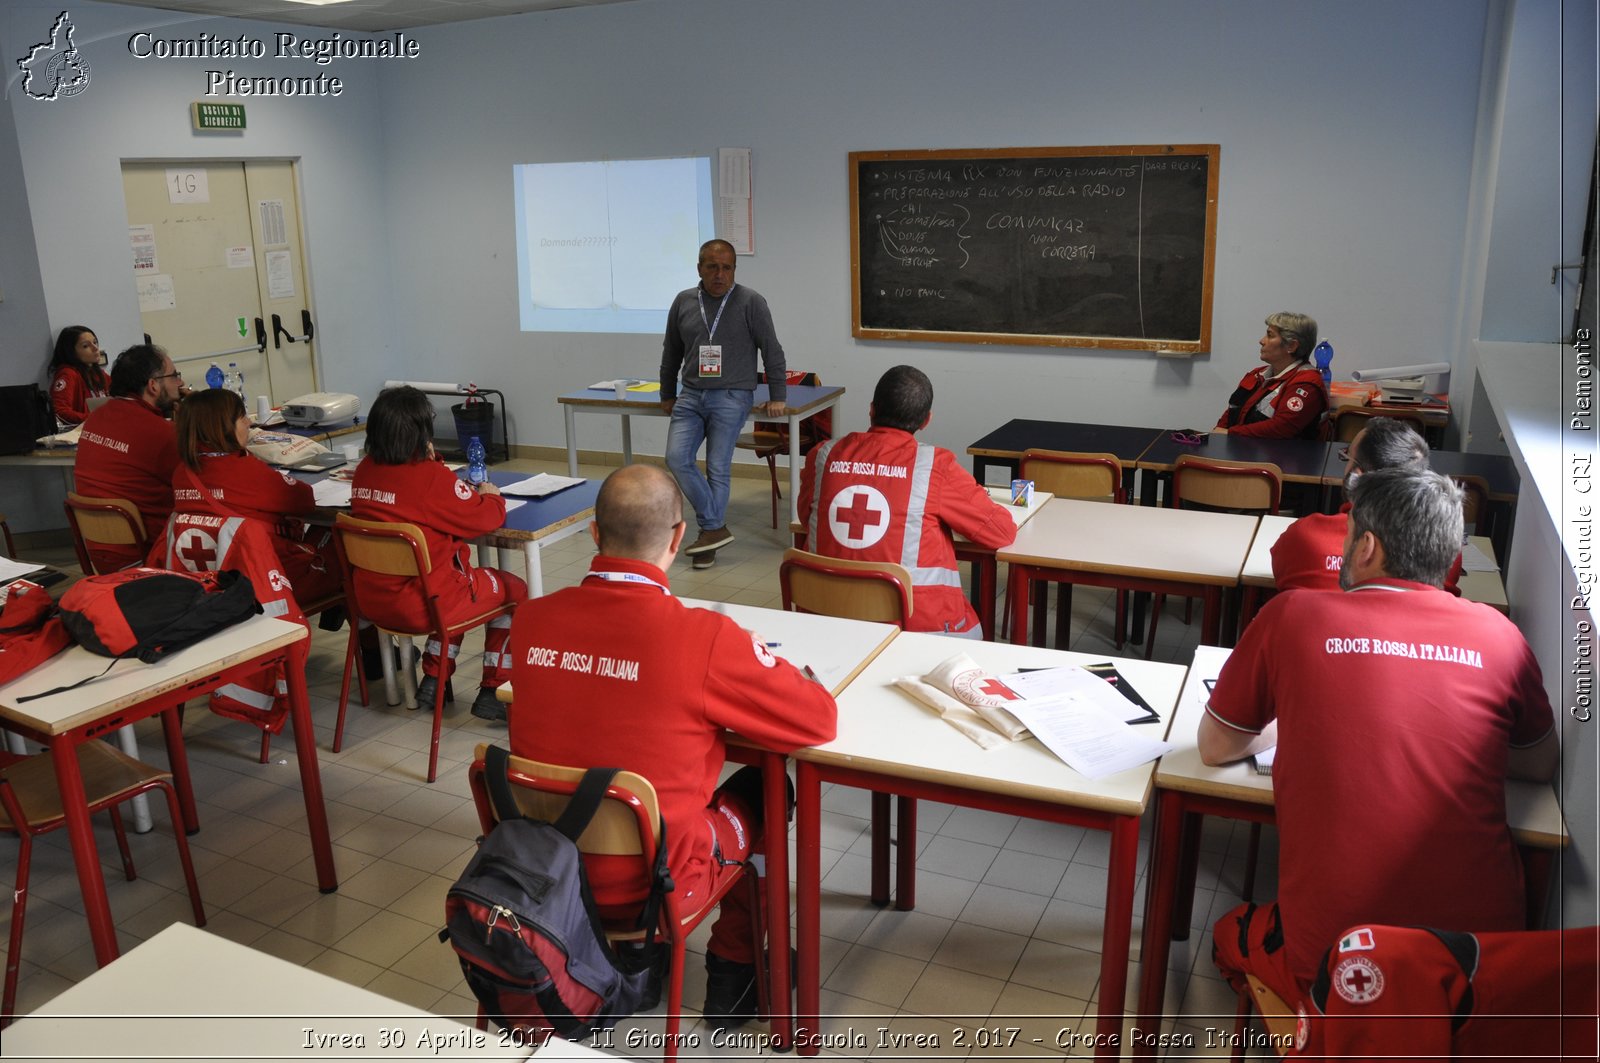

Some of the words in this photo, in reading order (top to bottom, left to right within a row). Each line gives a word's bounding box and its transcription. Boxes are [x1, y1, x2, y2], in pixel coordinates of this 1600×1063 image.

[203, 105, 229, 115] USCITA
[232, 106, 241, 116] DI
[204, 117, 241, 127] SICUREZZA
[881, 168, 952, 182] SISTEMA
[1034, 165, 1140, 178] FUNZIONANTE
[884, 186, 971, 200] PREPARAZIONE
[1038, 185, 1076, 196] DELLA
[1082, 184, 1126, 197] RADIO
[901, 203, 921, 214] CHI
[899, 232, 928, 242] DOVE
[1029, 234, 1057, 244] NON
[900, 245, 935, 255] QUANDO
[1042, 245, 1096, 260] CORRETTA
[896, 287, 912, 298] NO
[918, 288, 945, 299] PANIC
[103, 437, 129, 454] ITALIANA
[829, 461, 852, 474] CROCE
[852, 462, 875, 476] ROSSA
[877, 464, 907, 479] ITALIANA
[357, 487, 371, 500] ROSSA
[372, 489, 396, 505] ITALIANA
[1325, 555, 1342, 570] CRO
[1325, 638, 1370, 654] CROCE
[1372, 639, 1418, 659] ROSSA
[1420, 643, 1483, 669] ITALIANA
[527, 647, 558, 667] CROCE
[560, 652, 593, 674] ROSSA
[596, 657, 639, 682] ITALIANA
